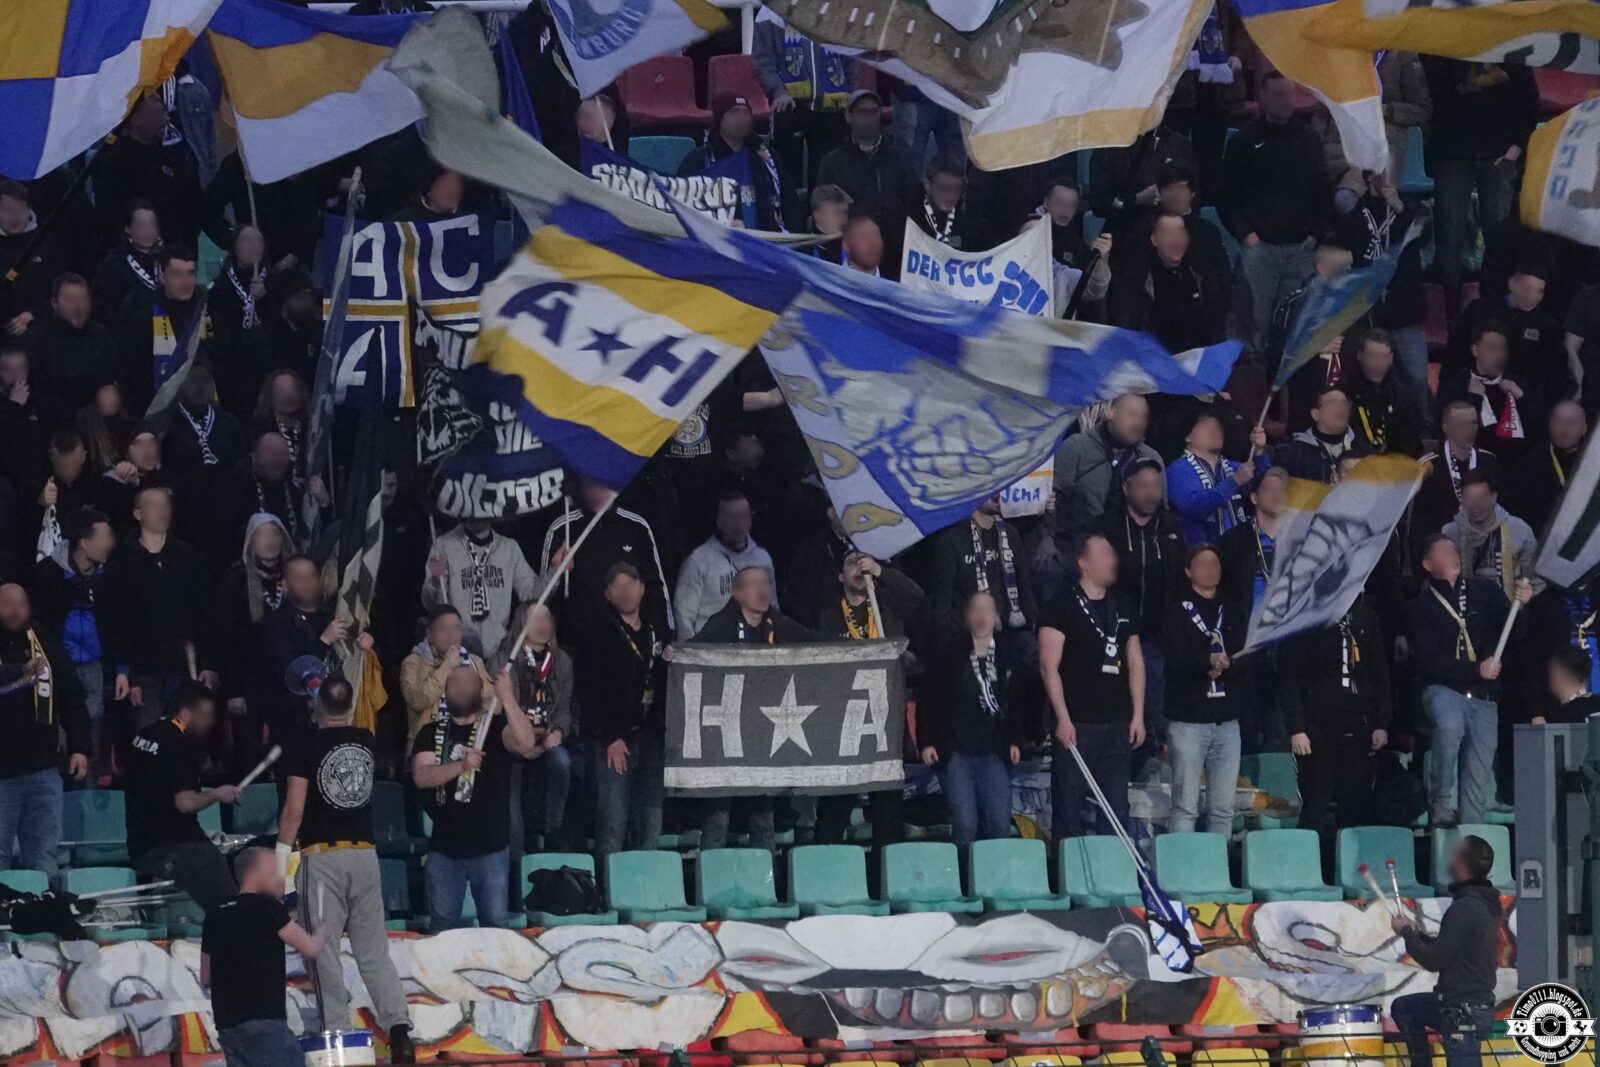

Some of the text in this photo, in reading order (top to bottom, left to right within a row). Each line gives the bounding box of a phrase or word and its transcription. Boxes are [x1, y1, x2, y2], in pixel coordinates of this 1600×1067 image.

[352, 214, 479, 297] A C
[906, 249, 994, 288] DER FCC
[682, 672, 745, 759] H
